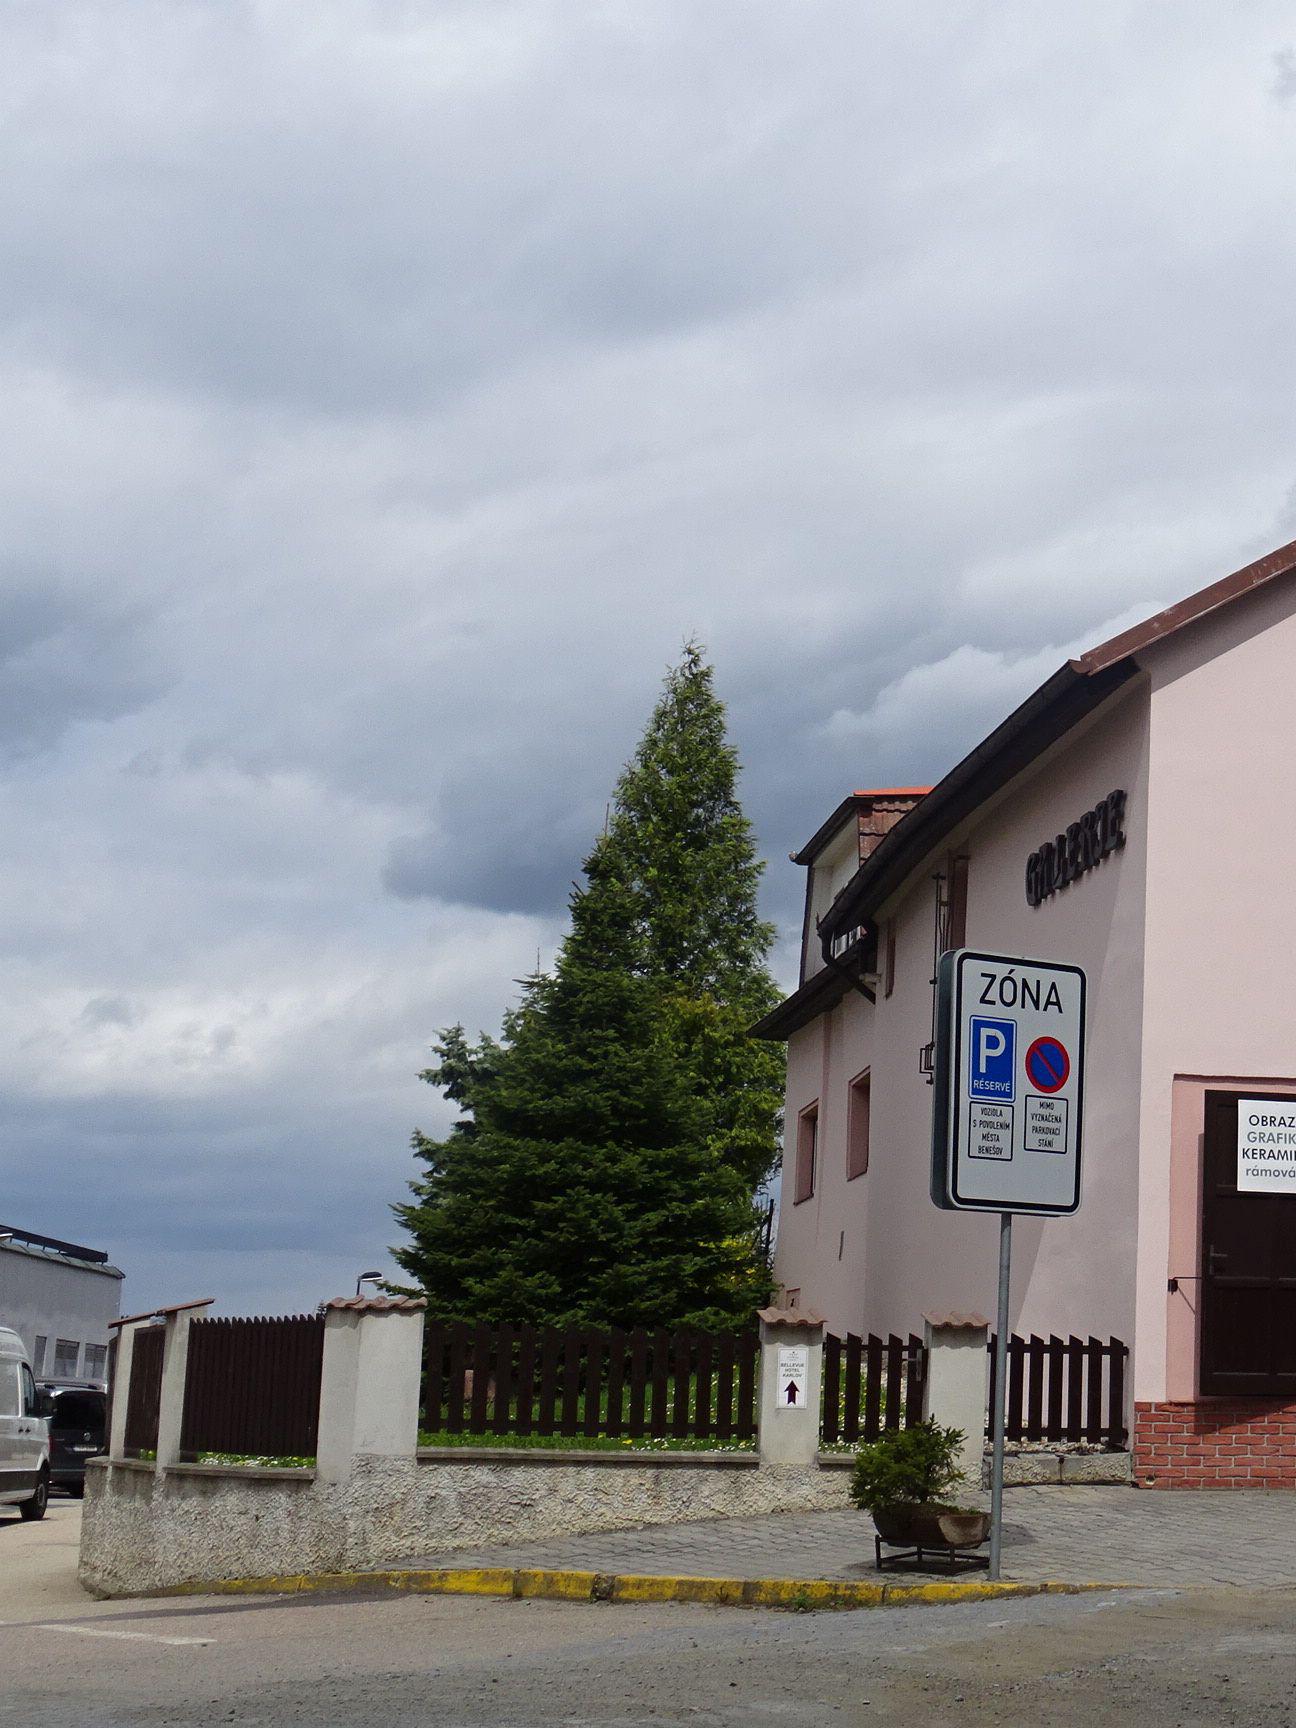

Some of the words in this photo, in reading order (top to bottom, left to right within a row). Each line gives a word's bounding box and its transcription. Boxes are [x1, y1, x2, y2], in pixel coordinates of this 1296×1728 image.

[979, 968, 1064, 1014] ZÓNA
[979, 1027, 1006, 1074] P
[973, 1078, 1011, 1093] RÉSERVÉ
[980, 1107, 1003, 1117] VOZIDLA
[1039, 1101, 1054, 1111] MIMO
[972, 1119, 977, 1128] S
[978, 1119, 1010, 1130] POVOLENÍM
[977, 1144, 1003, 1156] BENEŠOV
